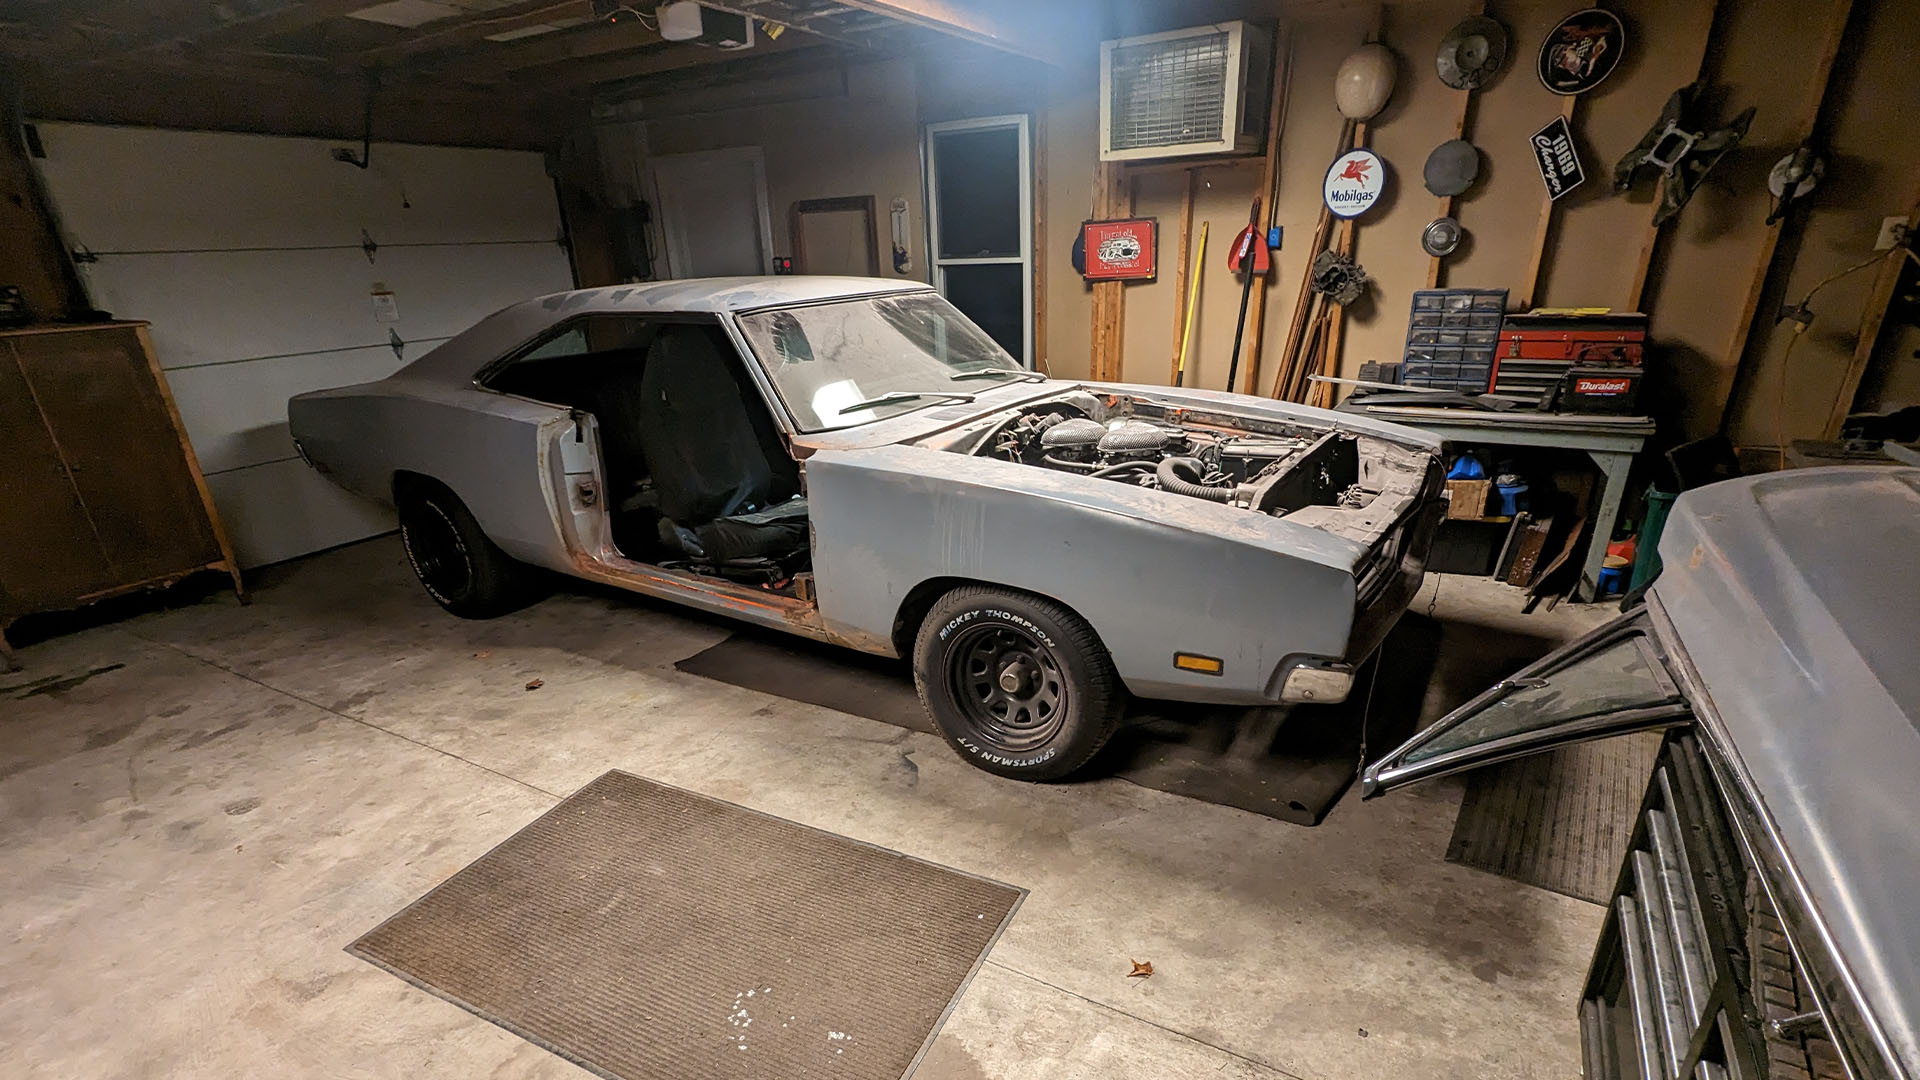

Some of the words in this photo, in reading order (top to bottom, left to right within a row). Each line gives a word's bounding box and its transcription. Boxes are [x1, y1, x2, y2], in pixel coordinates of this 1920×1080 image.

[1535, 135, 1562, 193] Charger
[1552, 134, 1576, 176] 1969
[1331, 189, 1374, 204] Mobilgas
[1580, 381, 1626, 391] Duralast
[939, 610, 980, 640] MICKEY
[985, 609, 1055, 648] THOMPSON
[957, 736, 980, 754] S/T
[981, 747, 1055, 767] SPORTSMAN
